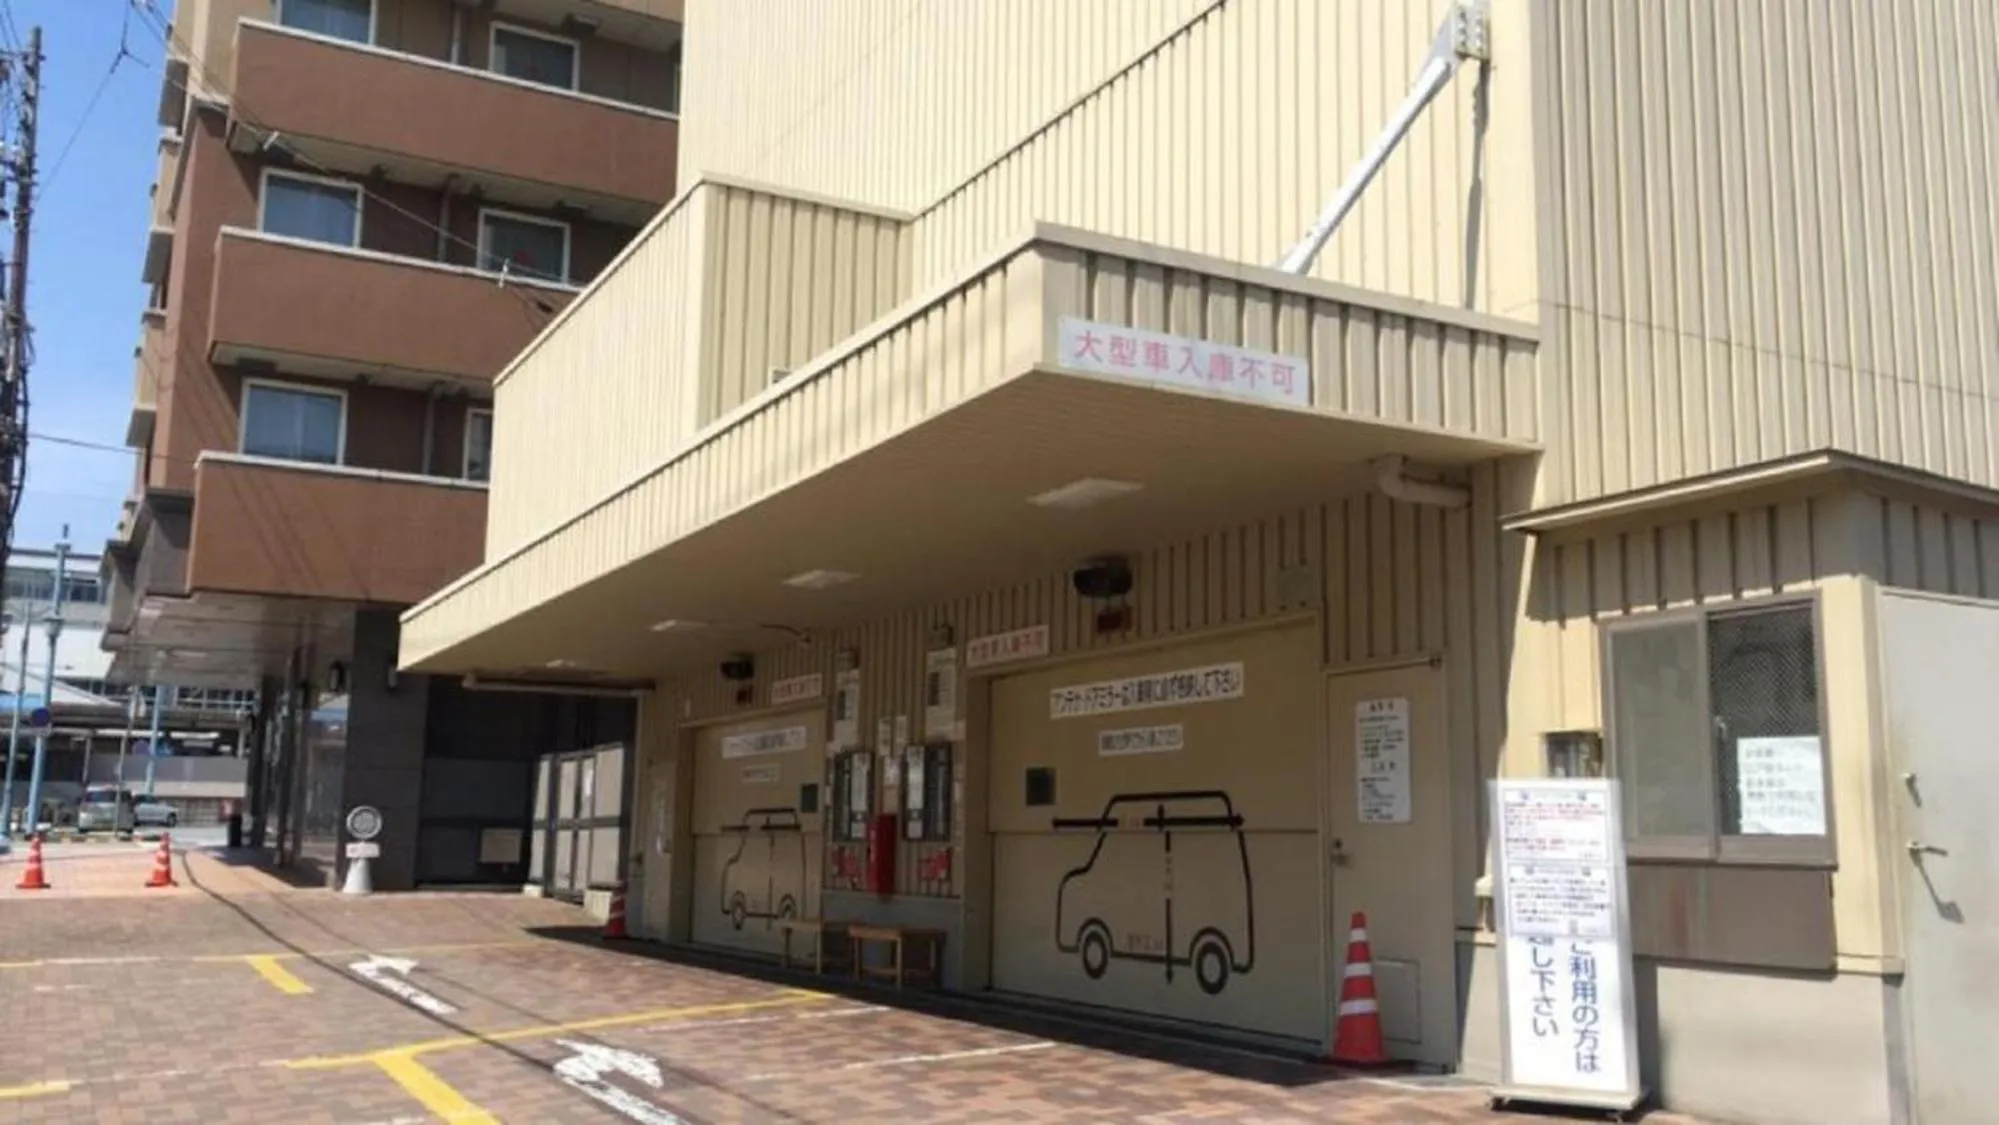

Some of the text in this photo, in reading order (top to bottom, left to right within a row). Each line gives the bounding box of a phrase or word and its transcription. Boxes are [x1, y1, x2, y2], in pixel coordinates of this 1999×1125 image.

[1074, 330, 1296, 395] 大型車入庫不可
